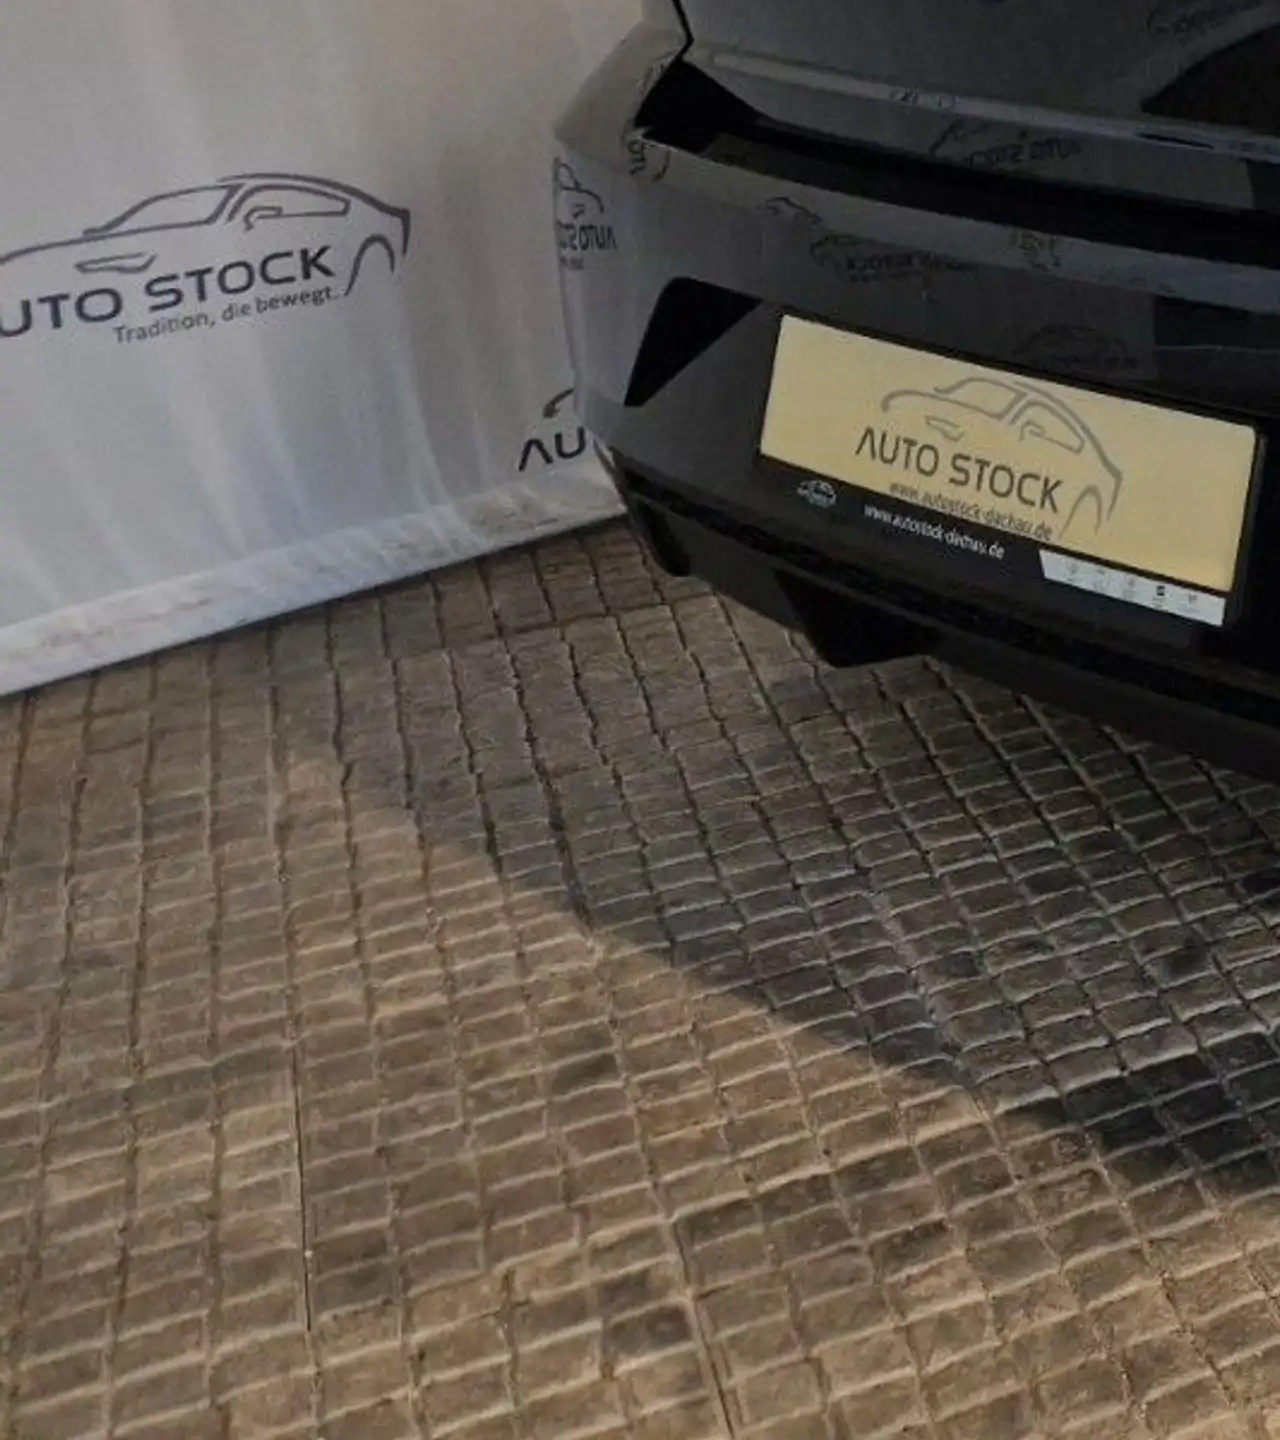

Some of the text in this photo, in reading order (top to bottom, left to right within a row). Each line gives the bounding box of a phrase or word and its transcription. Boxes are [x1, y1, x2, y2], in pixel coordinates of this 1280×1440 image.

[145, 245, 335, 313] STOCK
[113, 311, 216, 343] Tradition,
[221, 299, 251, 324] die
[518, 426, 586, 472] AU
[855, 427, 1064, 513] AUTO STOCK
